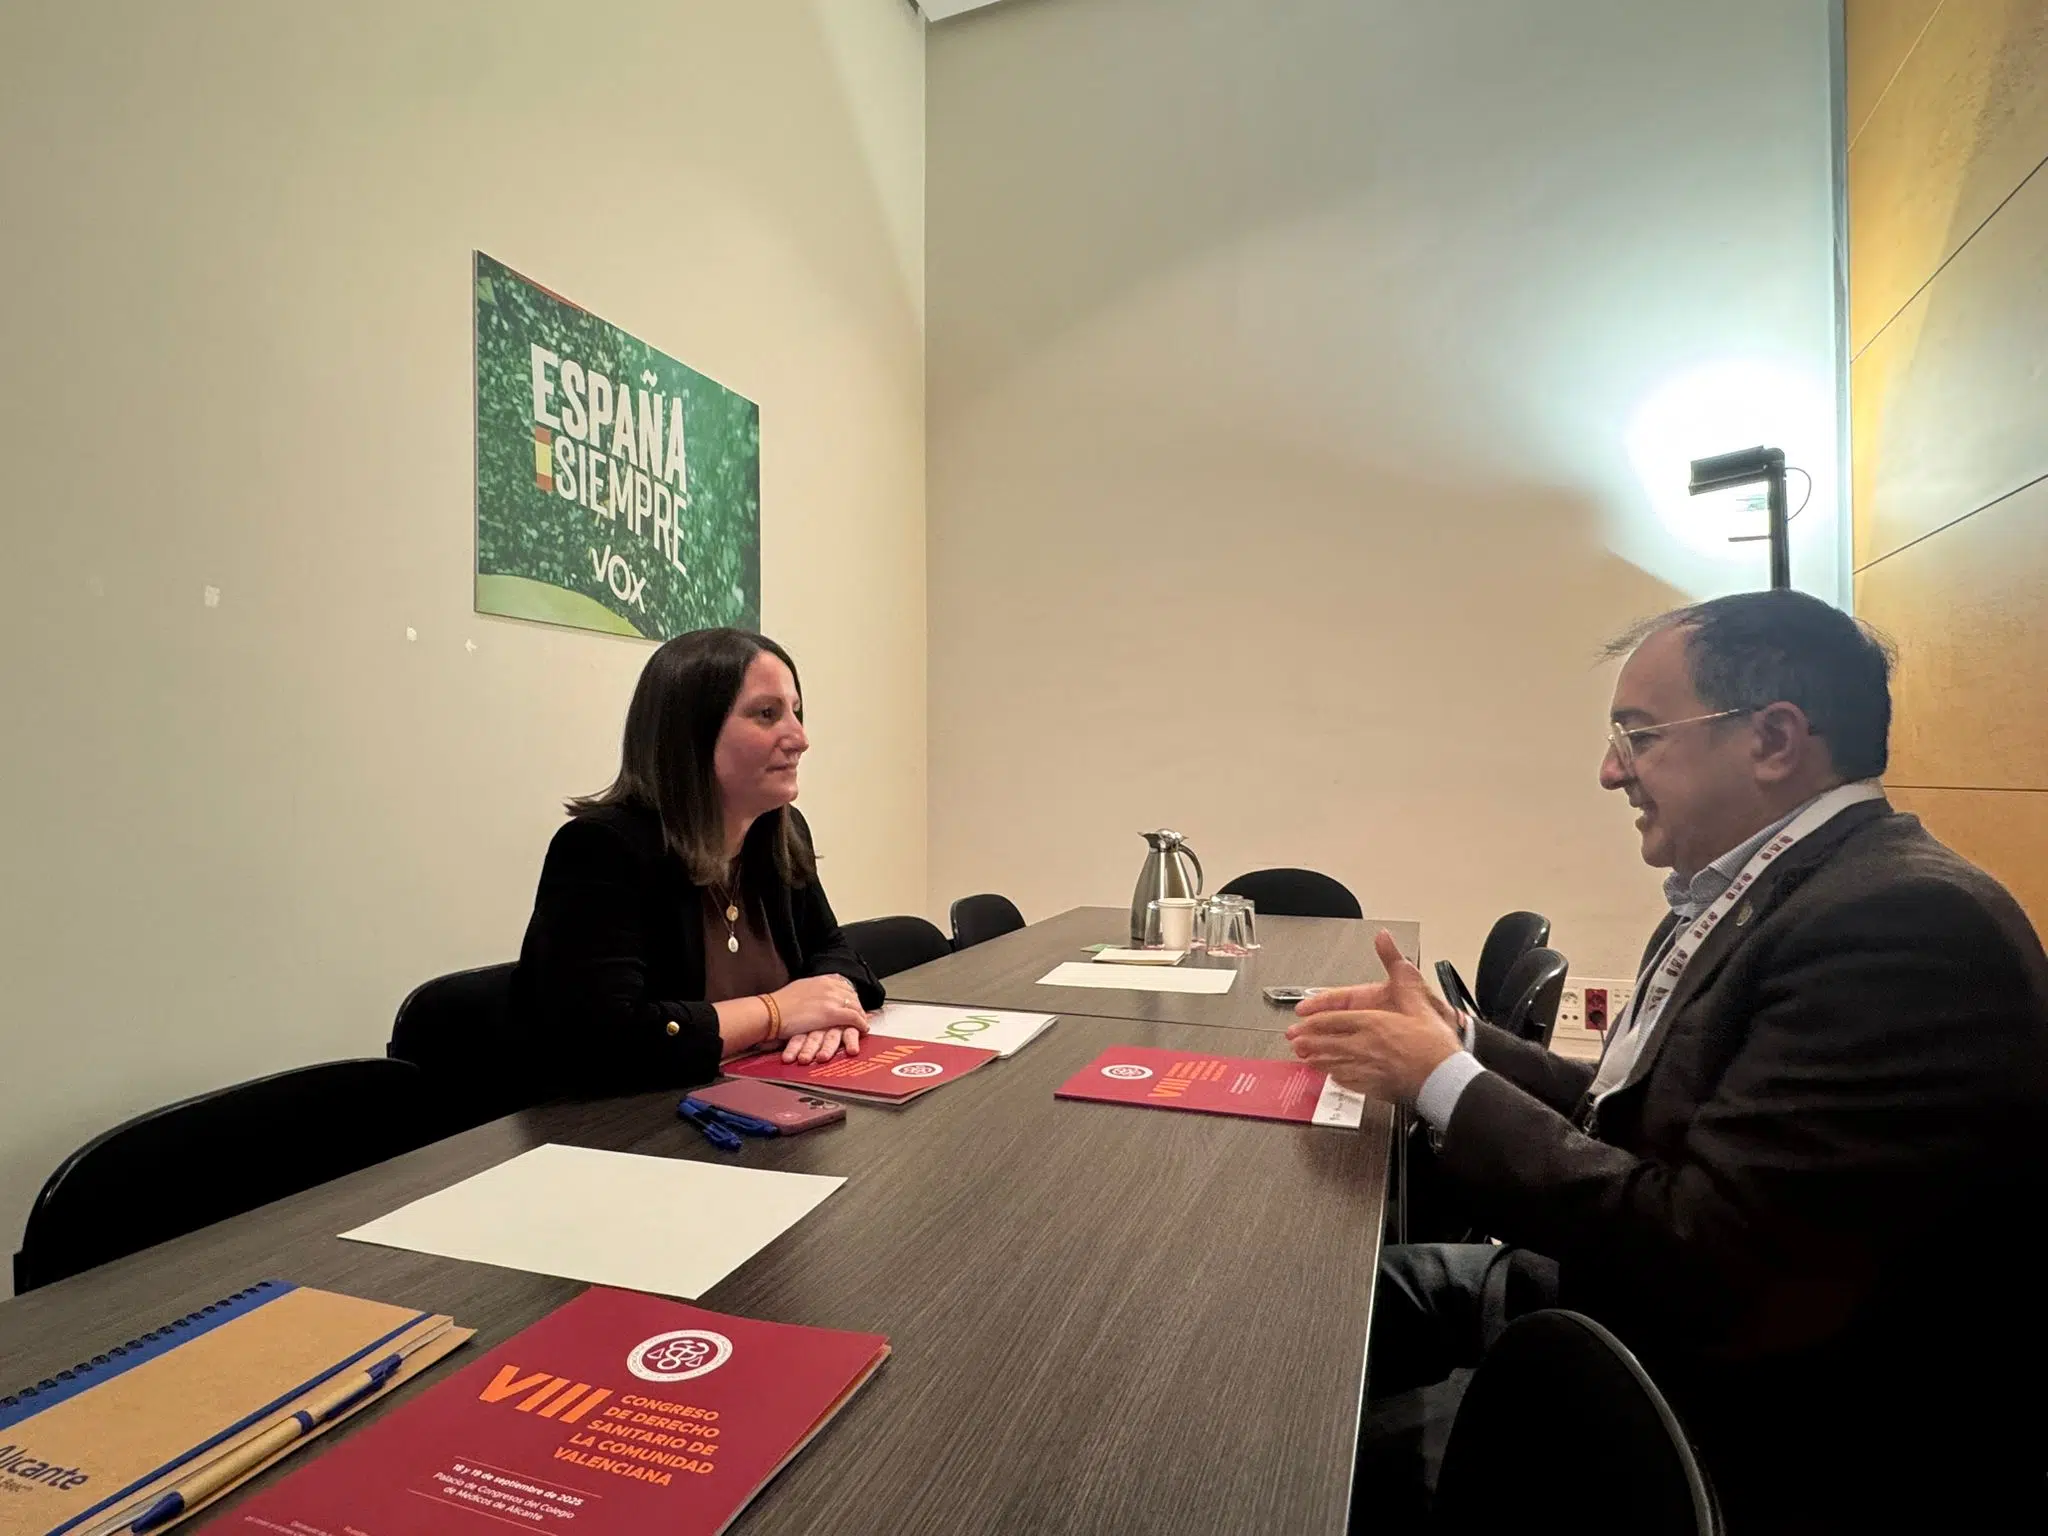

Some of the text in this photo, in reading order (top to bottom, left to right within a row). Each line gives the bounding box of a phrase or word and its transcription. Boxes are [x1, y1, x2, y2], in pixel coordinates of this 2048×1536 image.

[530, 342, 687, 494] ESPAÑA
[554, 435, 687, 576] SIEMPRE
[591, 544, 647, 614] VOX
[935, 1014, 1001, 1042] VOX
[478, 1364, 614, 1424] VIII
[621, 1394, 719, 1421] CONGRESO
[587, 1419, 719, 1457] SANITARIO DE
[602, 1406, 720, 1439] DE DERECHO
[553, 1446, 673, 1487] VALENCIANA
[569, 1432, 714, 1475] LA COMUNIDAD
[432, 1471, 575, 1520] Palacio de Congresos del Colegio
[443, 1486, 544, 1522] de Médicos de Alicante
[481, 1469, 494, 1481] de
[493, 1475, 545, 1497] septiembre
[543, 1491, 557, 1499] de
[557, 1493, 584, 1507] 2025
